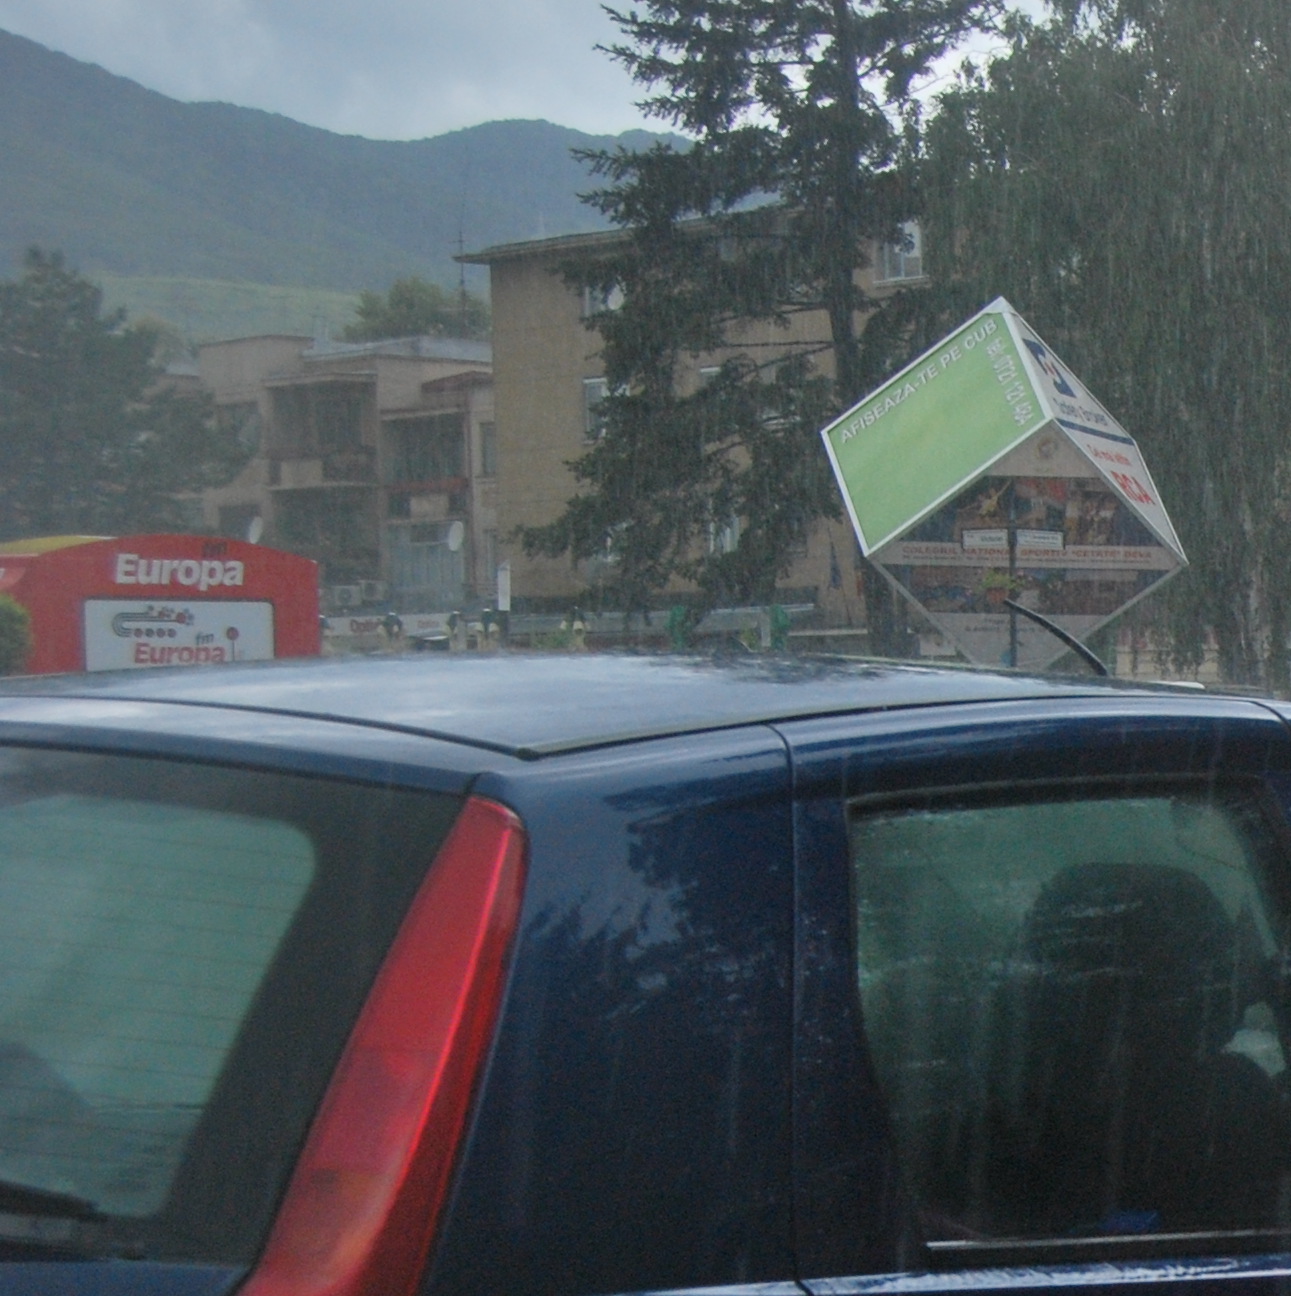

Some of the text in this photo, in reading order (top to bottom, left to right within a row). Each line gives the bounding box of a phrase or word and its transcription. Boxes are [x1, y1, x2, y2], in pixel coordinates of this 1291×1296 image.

[840, 318, 999, 443] AFISEAZA-TE PE CUB
[1110, 469, 1157, 506] RCA
[115, 553, 244, 591] Europa
[1124, 549, 1153, 560] DEVA
[134, 643, 226, 666] Europa
